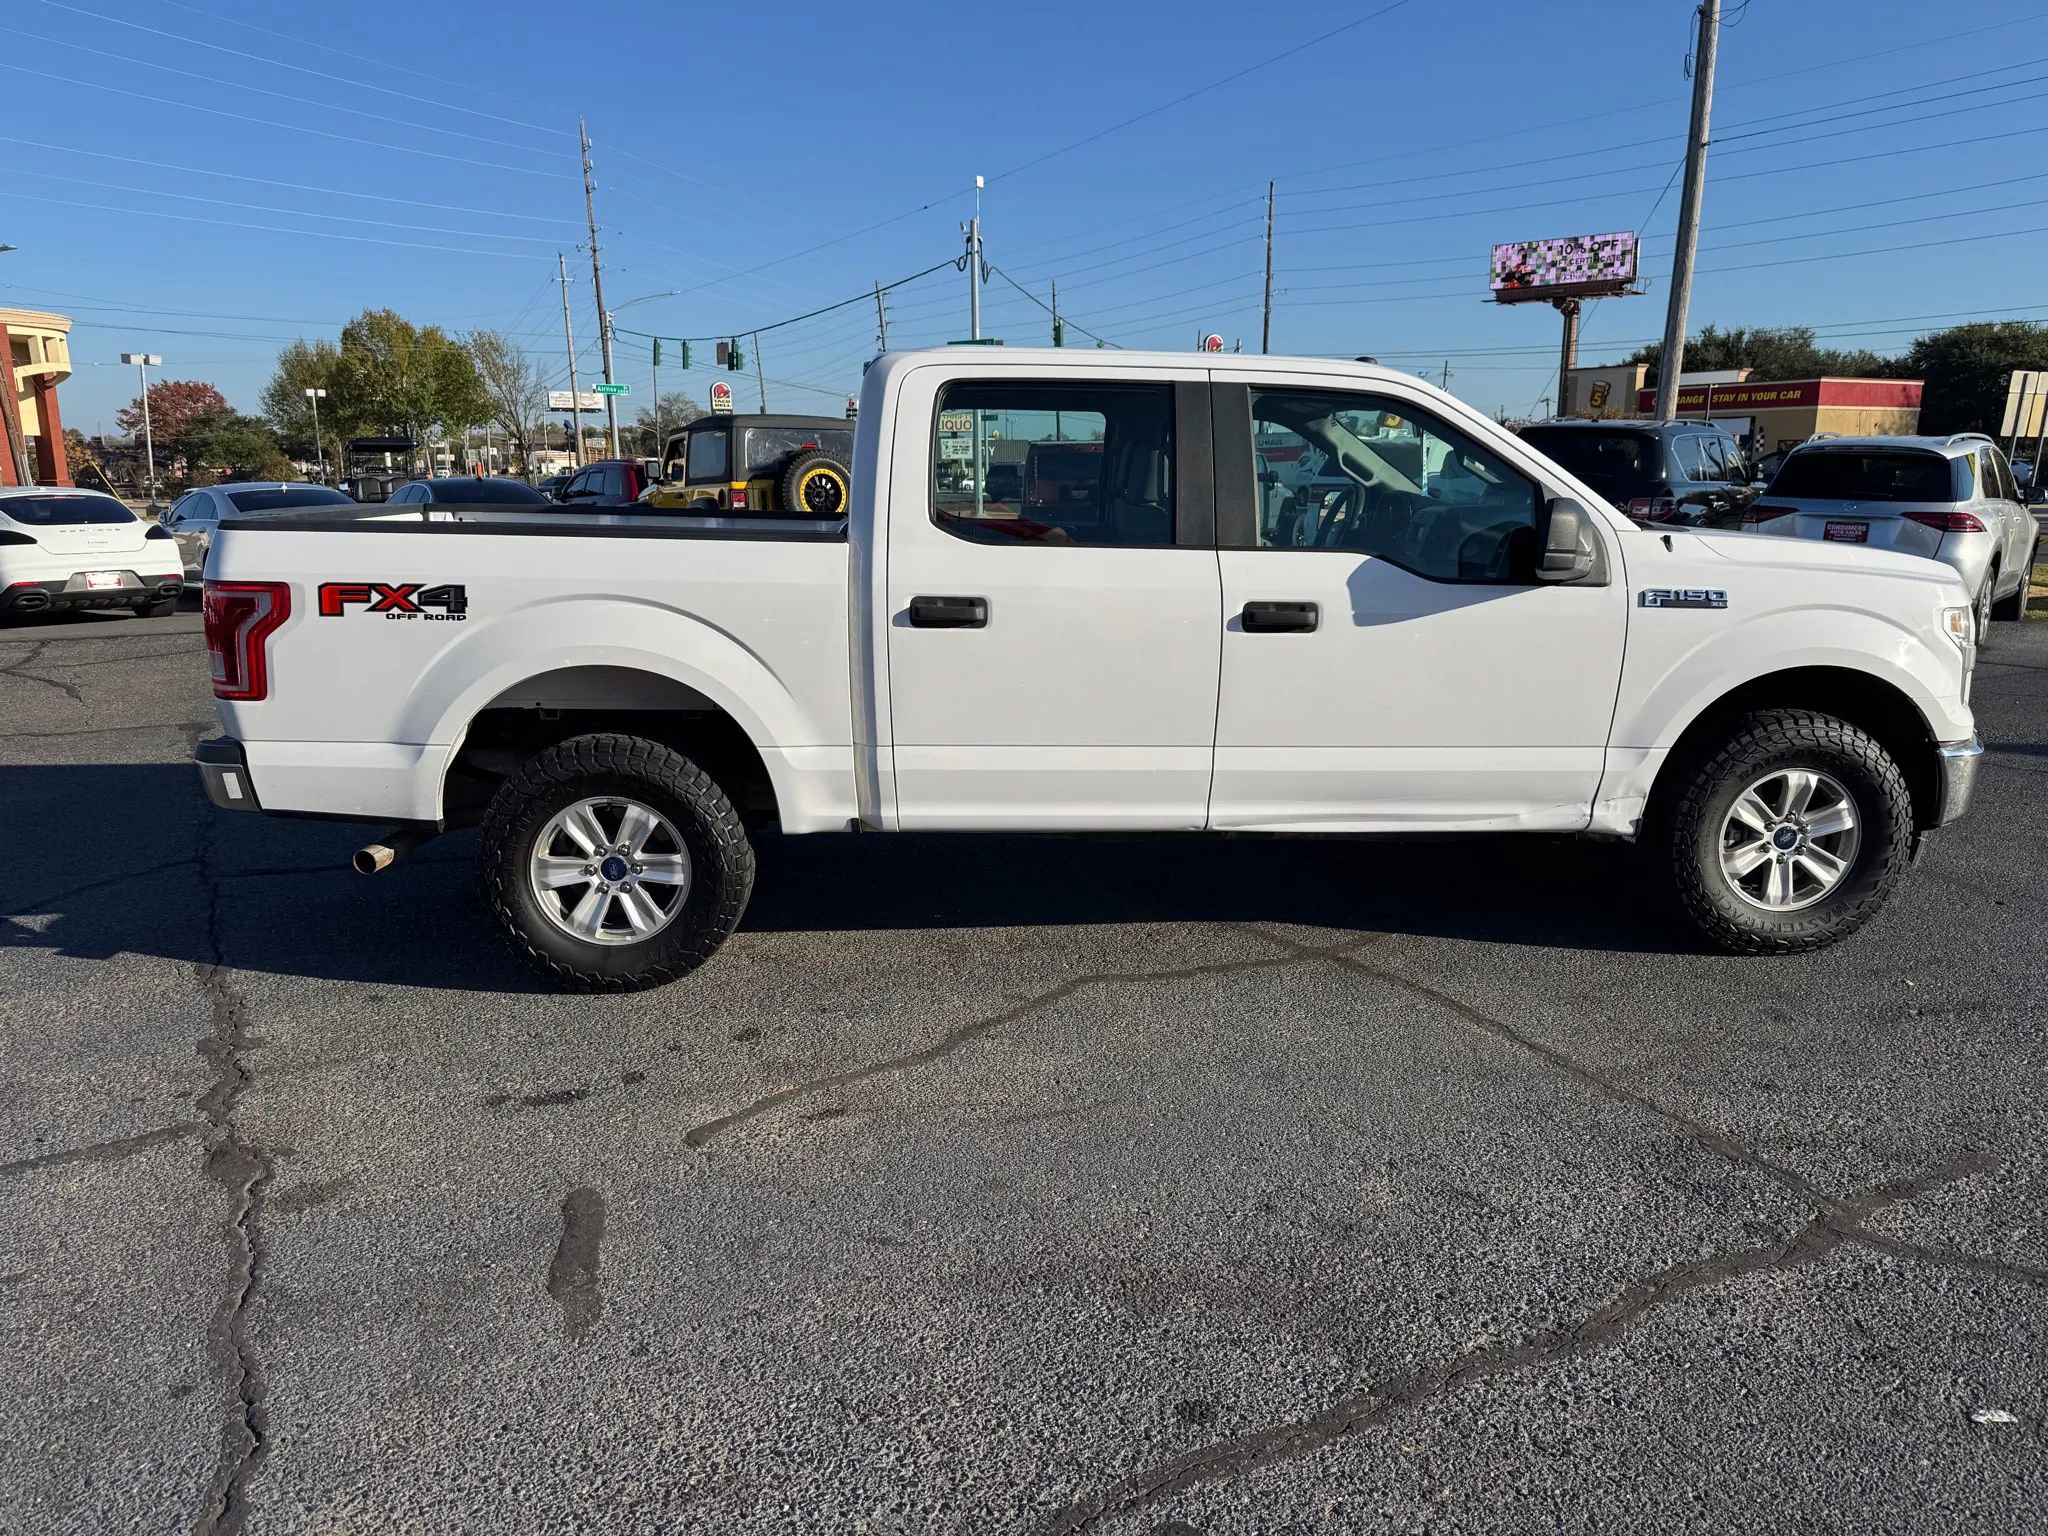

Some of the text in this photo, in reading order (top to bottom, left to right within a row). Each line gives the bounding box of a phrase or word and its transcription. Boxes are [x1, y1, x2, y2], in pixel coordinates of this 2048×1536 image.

[1559, 239, 1619, 256] 10% OFF
[1568, 254, 1627, 266] CERTICATES
[1677, 395, 1705, 405] ANGE
[1711, 389, 1802, 404] STAY IN YOUR CAR
[940, 419, 973, 431] IQUO
[1826, 523, 1867, 532] CONSUMERS
[317, 582, 468, 617] FX4
[423, 613, 467, 621] ROAD
